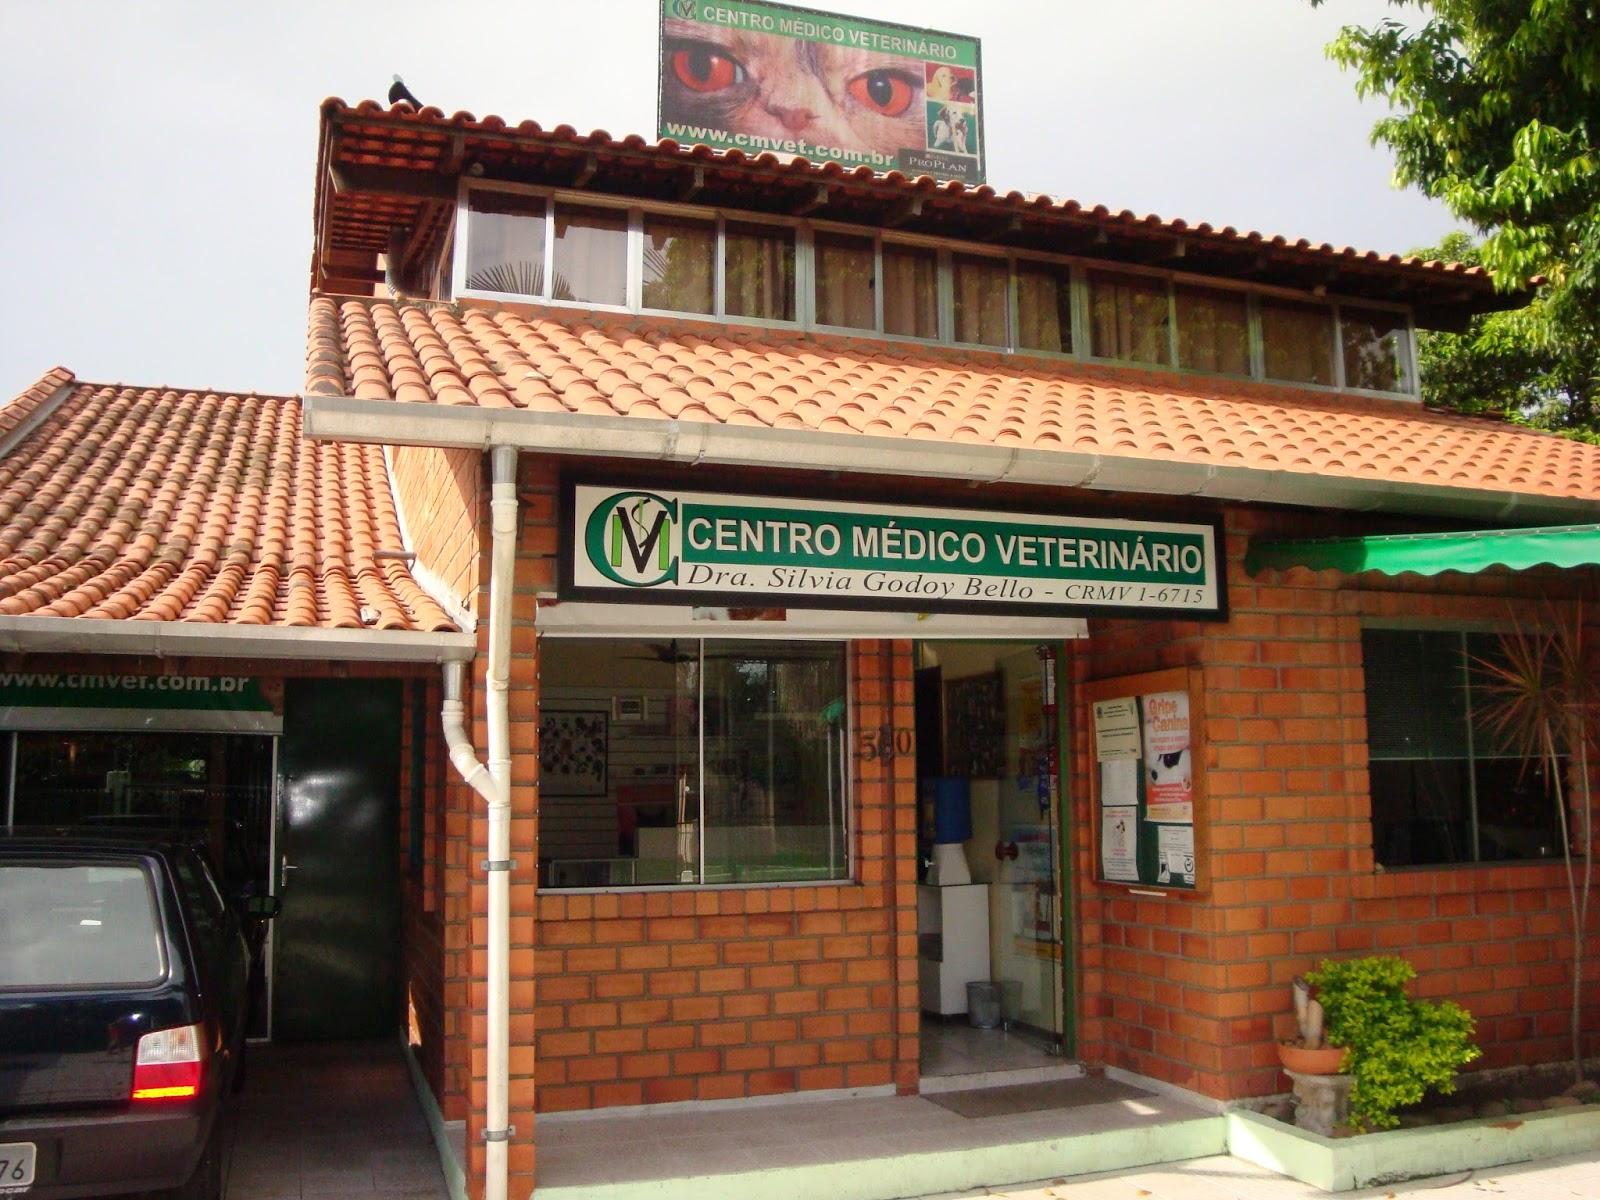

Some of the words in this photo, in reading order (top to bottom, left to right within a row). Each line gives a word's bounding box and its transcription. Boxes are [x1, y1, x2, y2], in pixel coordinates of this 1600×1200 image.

[704, 5, 774, 31] CENTRO
[779, 17, 844, 43] MÉDICO
[848, 29, 957, 60] VETERINÁRIO
[666, 122, 894, 167] www.cmvet.com.br
[687, 517, 841, 556] CENTRO
[852, 520, 986, 564] MÉDICO
[994, 533, 1202, 575] VETERINÁRIO
[687, 564, 755, 587] Dra.
[767, 567, 853, 591] Silvia
[863, 572, 955, 601] Godoy
[964, 576, 1034, 600] Bello
[1065, 583, 1131, 602] CRMV
